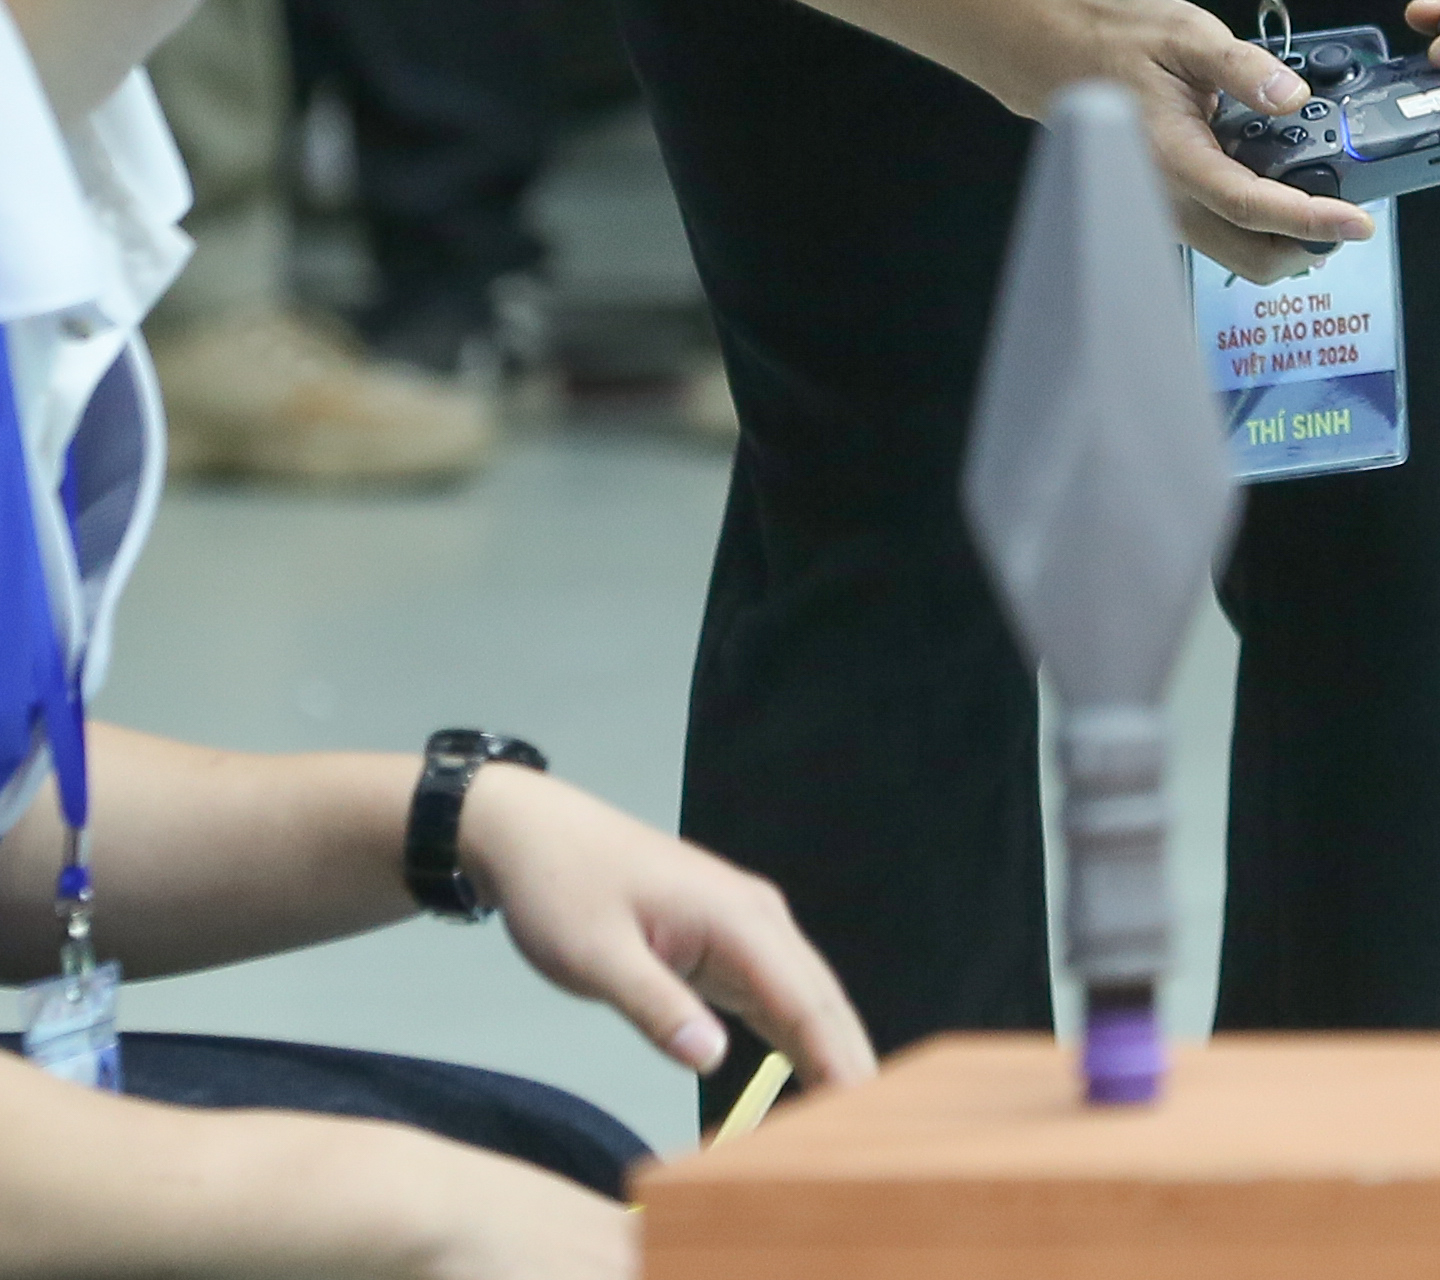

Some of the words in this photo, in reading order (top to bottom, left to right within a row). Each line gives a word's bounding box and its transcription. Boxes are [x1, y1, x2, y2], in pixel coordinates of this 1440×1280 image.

[1254, 293, 1304, 322] CUỘC
[1307, 292, 1332, 314] THI
[1217, 325, 1267, 351] SÁNG
[1272, 321, 1308, 348] TẠO
[1312, 313, 1371, 338] ROBOT
[1232, 352, 1266, 380] VIỆT
[1271, 349, 1312, 372] NAM
[1317, 345, 1360, 367] 2026
[1246, 409, 1287, 446] THÍ
[1292, 409, 1352, 439] SINH
